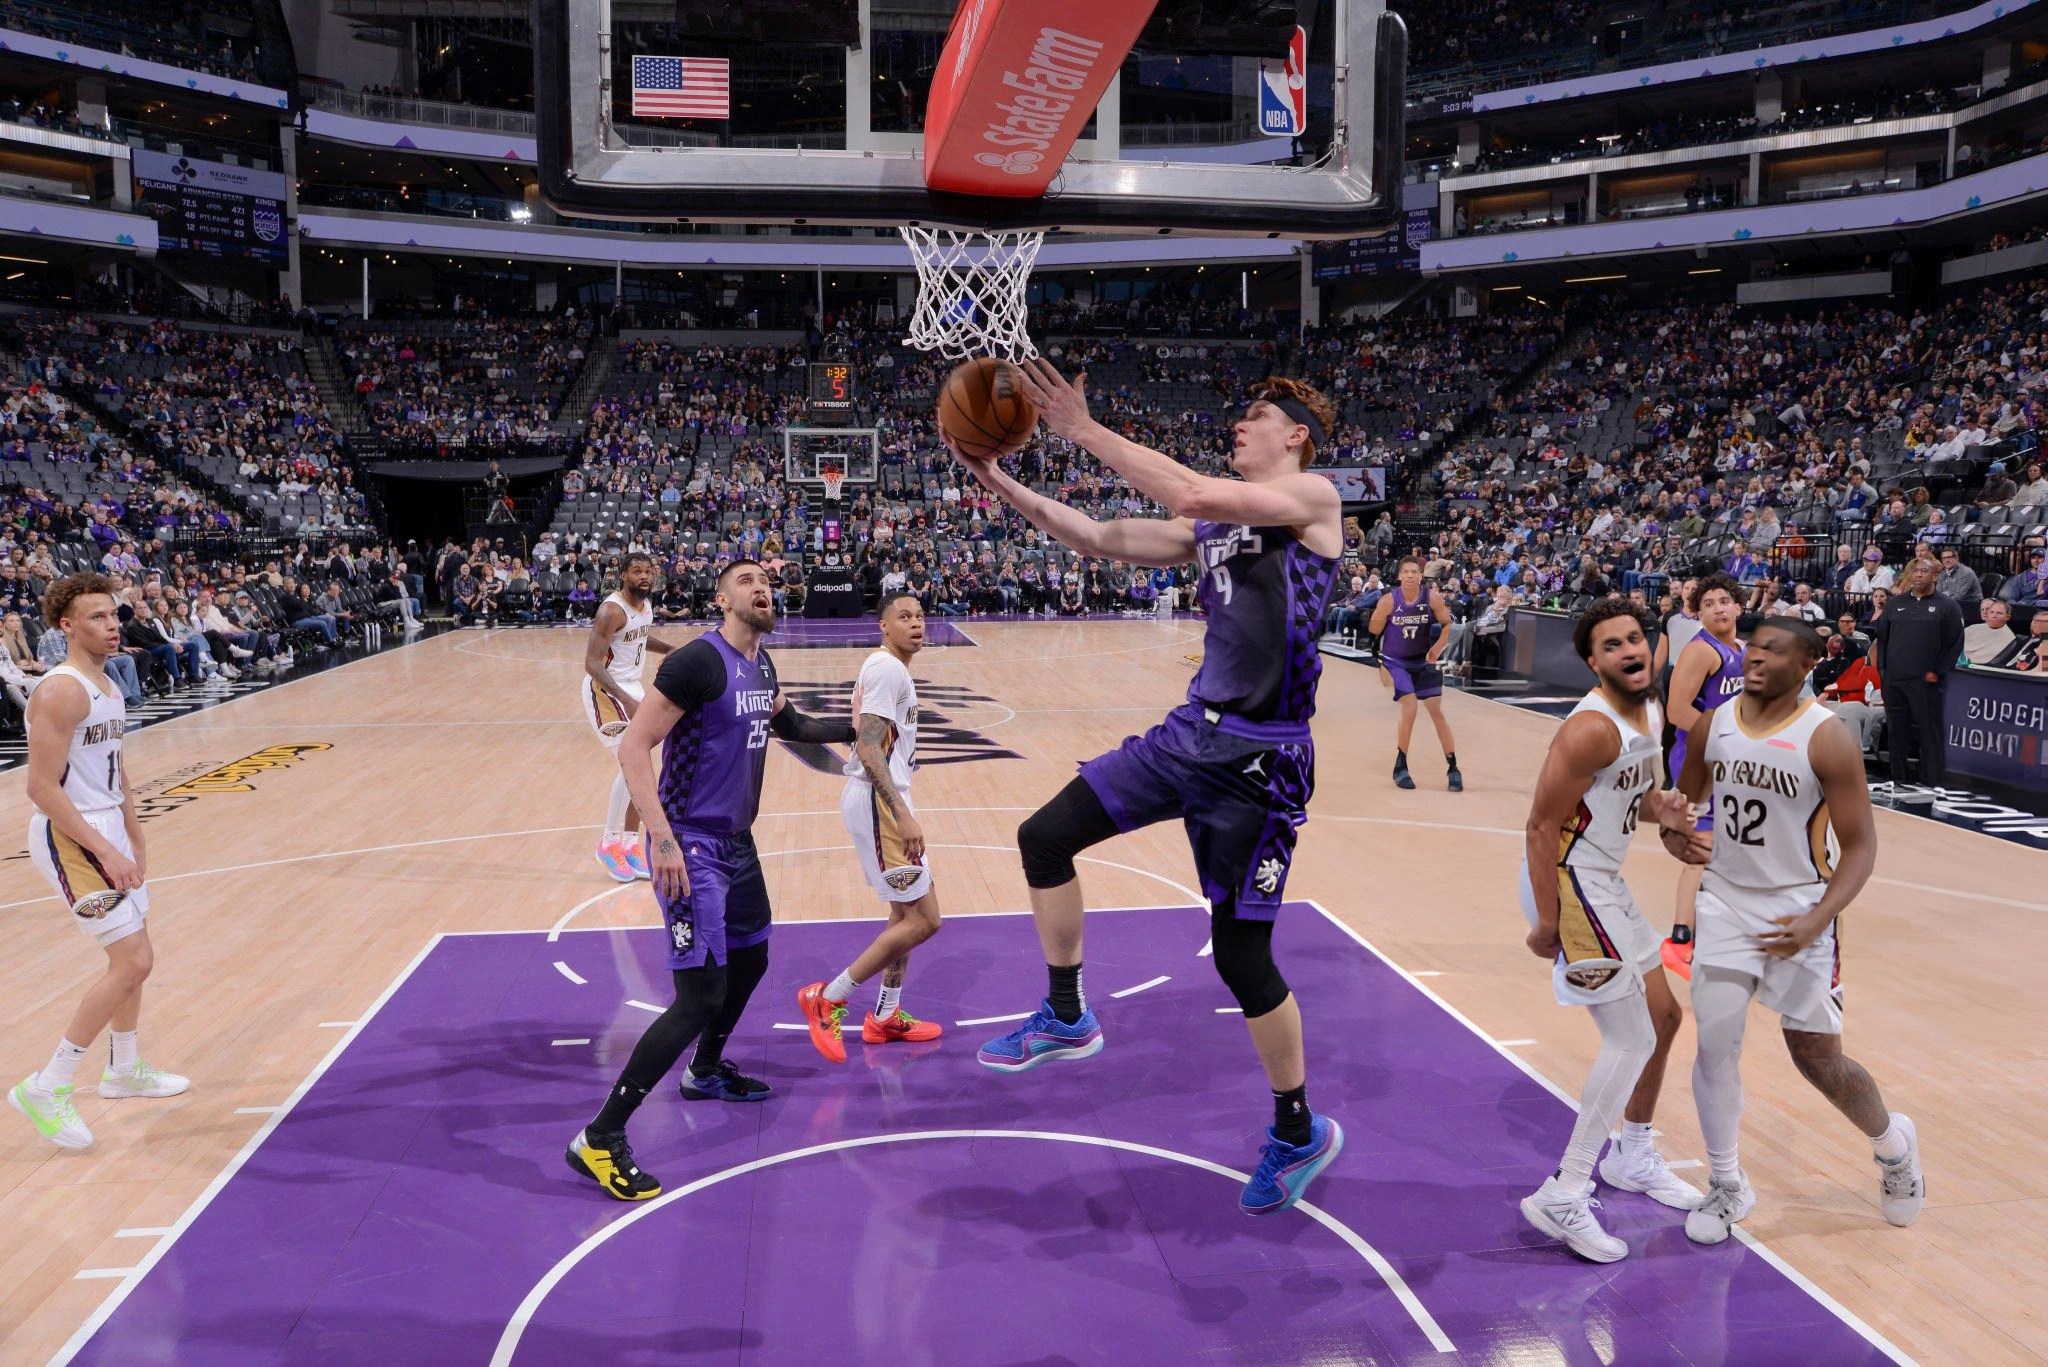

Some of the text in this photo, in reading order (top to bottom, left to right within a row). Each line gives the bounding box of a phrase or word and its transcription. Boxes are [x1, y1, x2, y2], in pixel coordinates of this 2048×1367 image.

[1442, 100, 1474, 113] 5:03 PM
[1265, 110, 1288, 128] NBA
[209, 170, 249, 182] REDHAWK
[139, 179, 177, 192] PELICANS
[183, 187, 244, 203] ADVANCED STATS
[255, 198, 277, 207] KINGS
[182, 198, 197, 208] 72.5
[231, 206, 245, 215] 47.1
[199, 213, 211, 221] PTS
[233, 218, 244, 226] 40
[186, 223, 196, 231] 12
[234, 230, 245, 238] 23
[1388, 235, 1399, 243] 40
[827, 367, 847, 379] 1:32
[832, 378, 844, 399] 5
[813, 583, 844, 593] dialpad
[1211, 565, 1233, 606] 9
[623, 628, 639, 643] NEW
[634, 643, 643, 666] 8
[82, 720, 108, 747] NEW
[746, 719, 770, 749] 25
[1723, 794, 1767, 846] 32
